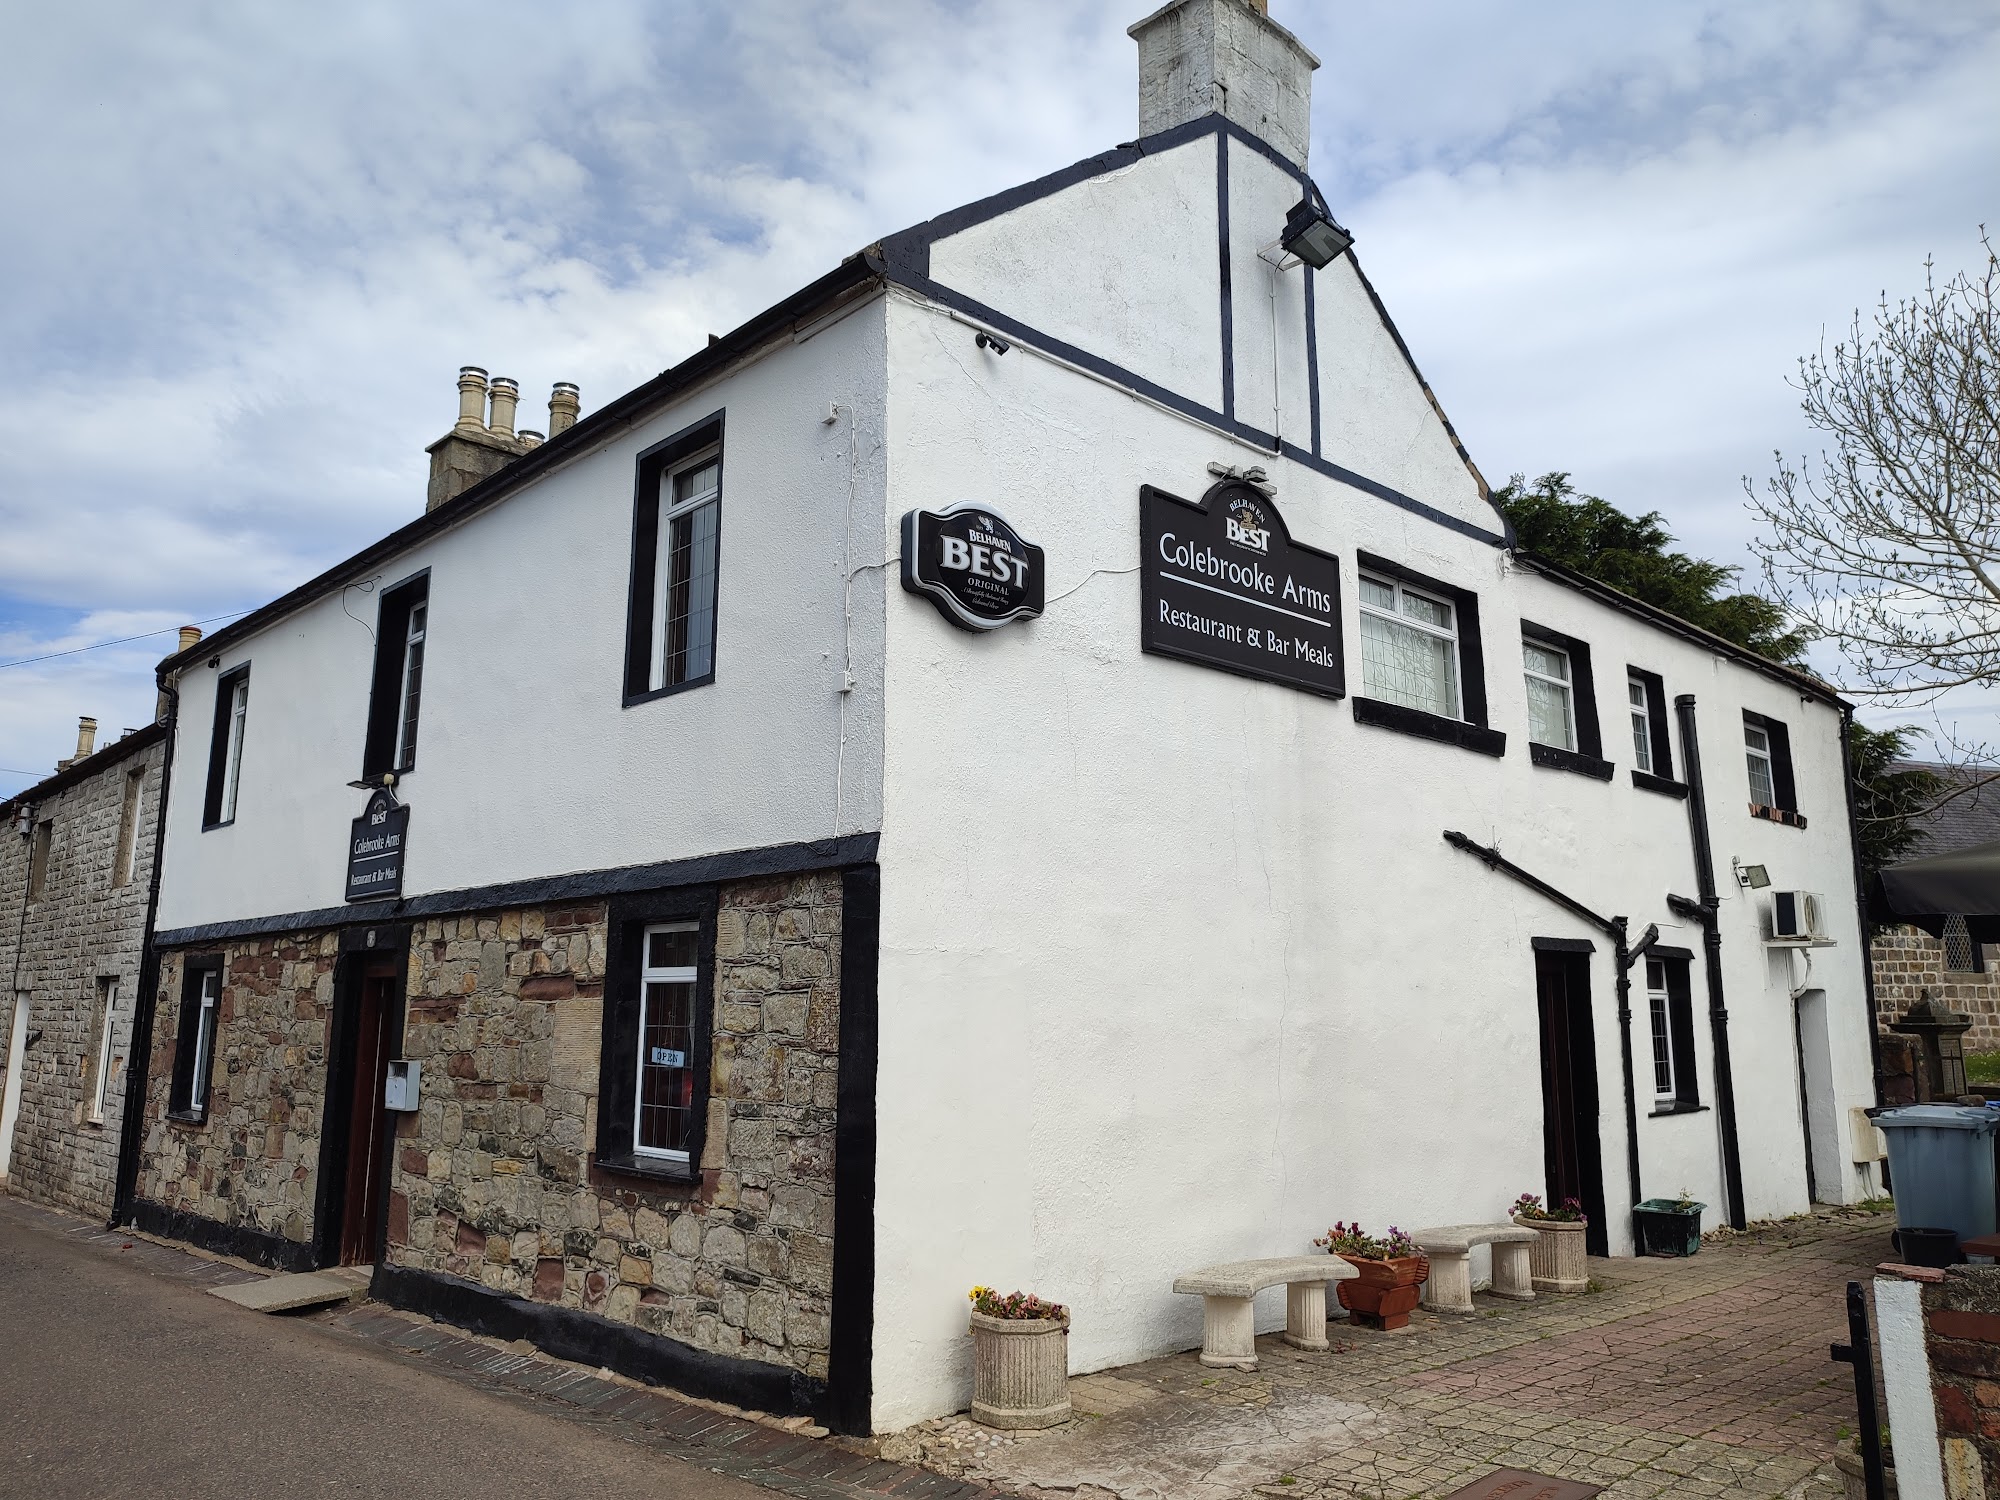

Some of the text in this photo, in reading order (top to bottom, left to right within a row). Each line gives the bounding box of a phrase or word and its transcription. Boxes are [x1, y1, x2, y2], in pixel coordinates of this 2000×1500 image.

[1229, 498, 1266, 523] BELHAVEN
[968, 528, 1012, 554] BELHAVEN
[1225, 516, 1271, 552] BEST
[939, 534, 1029, 589] BEST
[1159, 532, 1331, 613] Colebrooke Arms
[967, 577, 1010, 596] ORIGINAL
[1159, 598, 1333, 668] Restaurant & Bar Meals
[371, 810, 387, 825] BEST
[354, 832, 400, 855] Colebrooke Arms
[351, 874, 372, 886] Restaurant
[384, 866, 397, 881] Meals
[657, 1052, 678, 1063] OPEN
